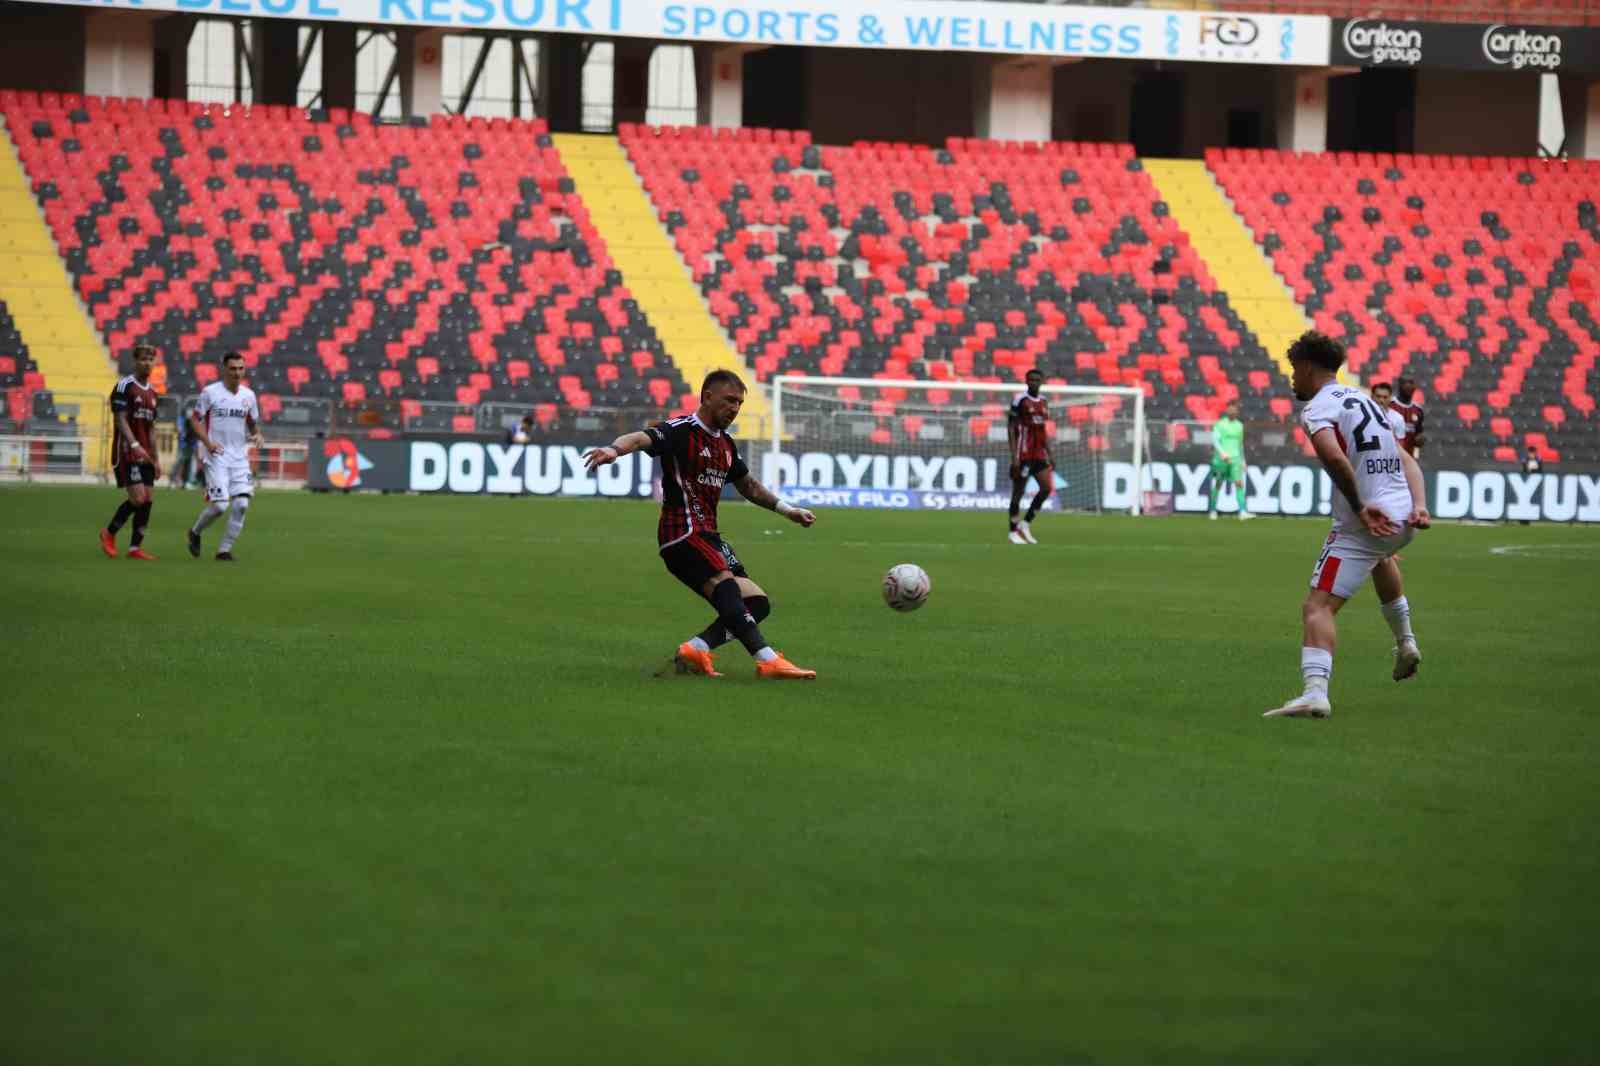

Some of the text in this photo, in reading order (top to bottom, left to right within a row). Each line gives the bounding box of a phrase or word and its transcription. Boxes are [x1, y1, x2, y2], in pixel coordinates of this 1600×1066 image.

[663, 5, 838, 42] SPORTS
[857, 14, 885, 44] &
[904, 16, 1142, 54] WELLNESS
[1374, 47, 1422, 65] group
[1511, 51, 1560, 69] group
[410, 441, 653, 497] DOYUYO!
[762, 451, 998, 494] DOYUYO!
